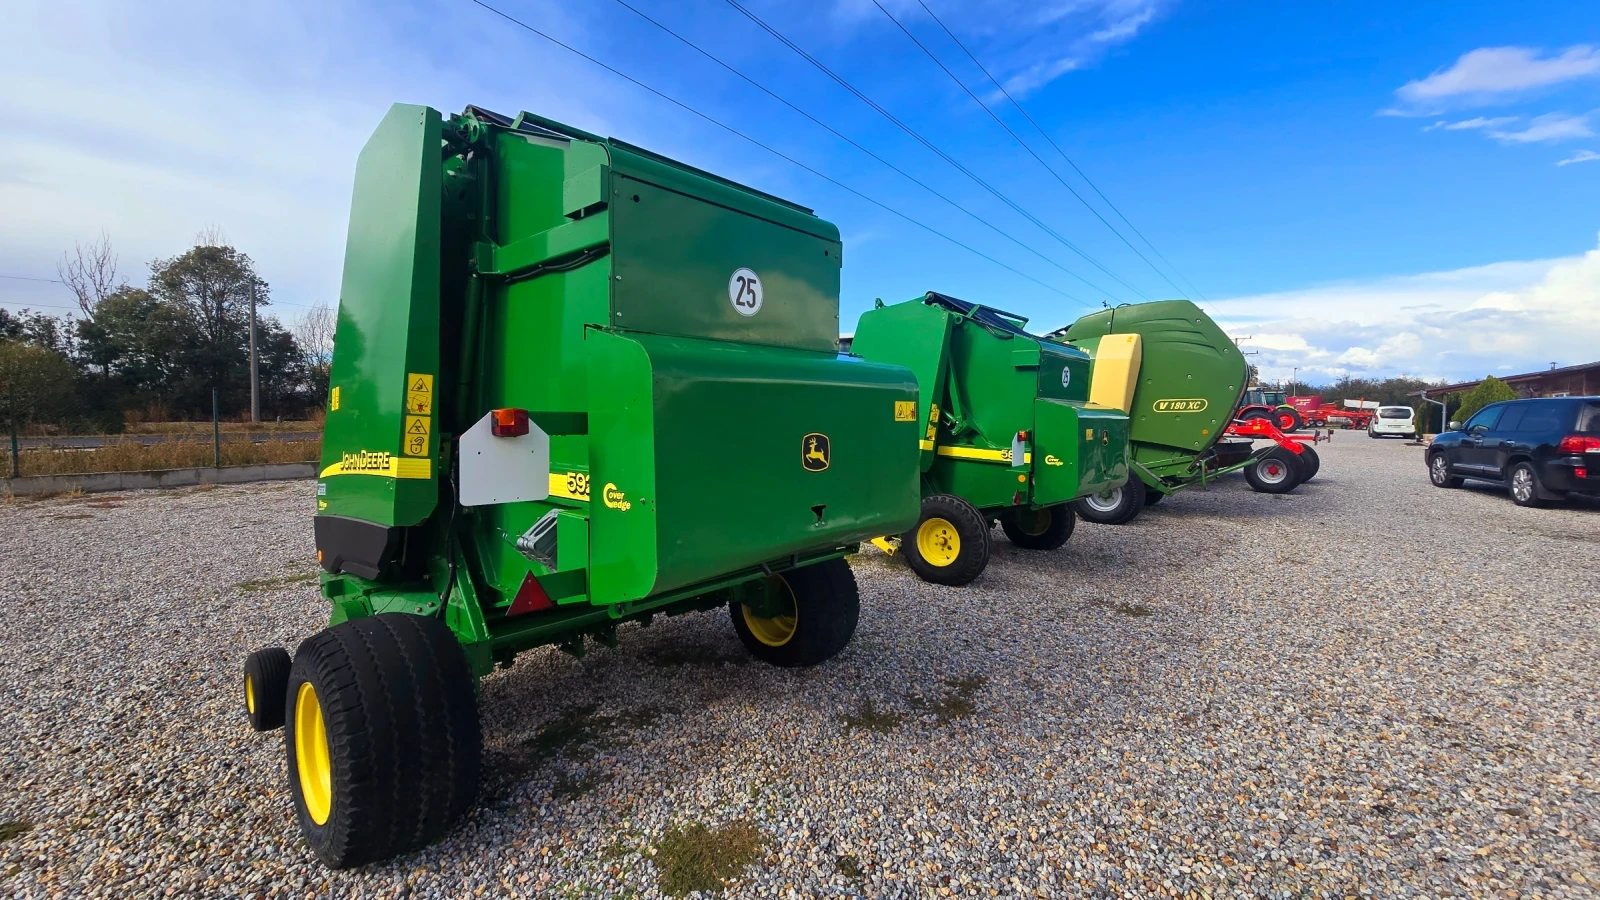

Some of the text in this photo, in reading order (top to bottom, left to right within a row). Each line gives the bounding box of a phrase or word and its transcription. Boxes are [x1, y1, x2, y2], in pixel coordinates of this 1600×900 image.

[736, 276, 757, 308] 25
[1063, 370, 1069, 384] 25
[1160, 402, 1201, 410] V 180 XC
[340, 450, 390, 470] JOHN DEERE
[603, 483, 625, 508] Cover
[613, 501, 631, 512] edge
